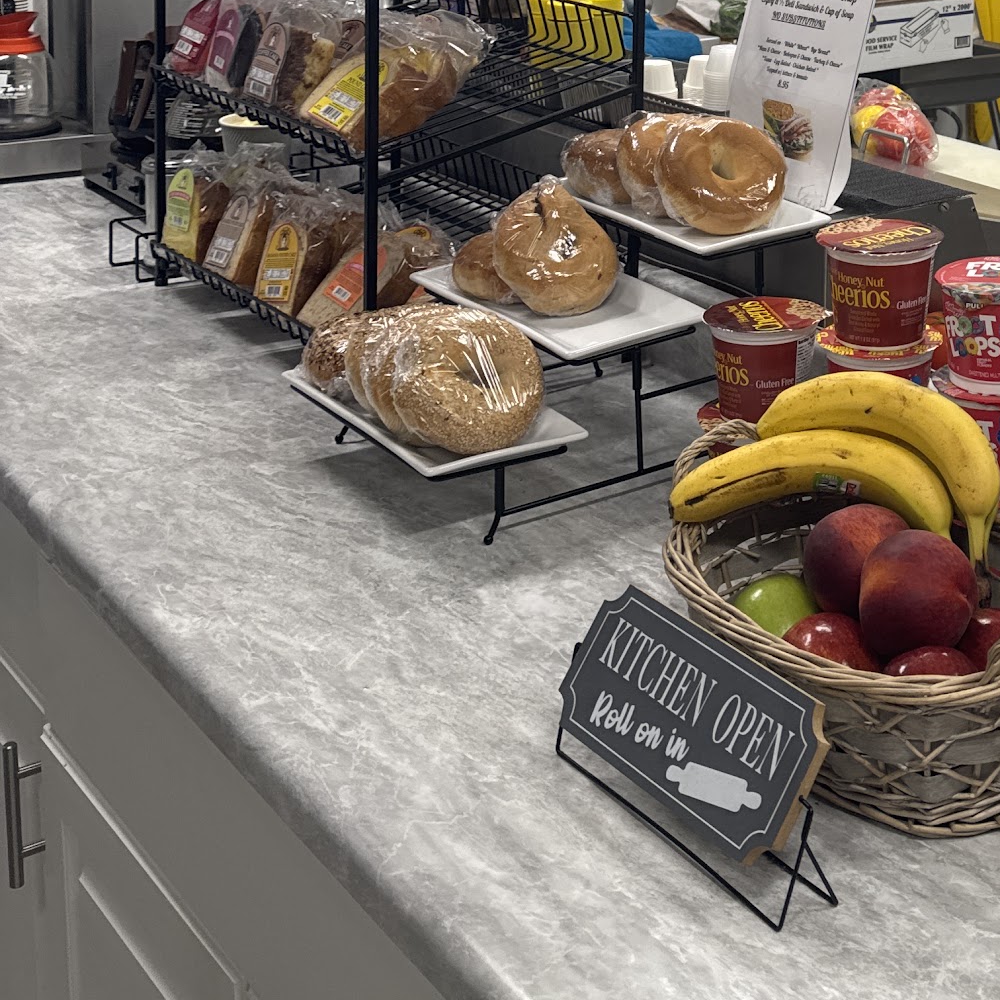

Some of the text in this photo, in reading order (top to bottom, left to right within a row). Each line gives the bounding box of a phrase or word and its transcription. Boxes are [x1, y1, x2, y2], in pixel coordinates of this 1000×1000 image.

[838, 272, 884, 287] Honey Nut
[896, 300, 918, 310] Gluten
[945, 315, 997, 337] FROOT
[950, 336, 1000, 358] LOOPS
[727, 353, 742, 365] Nut
[716, 361, 750, 386] erios
[755, 377, 795, 389] Gluten Free
[598, 617, 795, 781] KITCHEN OPEN
[589, 690, 690, 761] Roll on in
